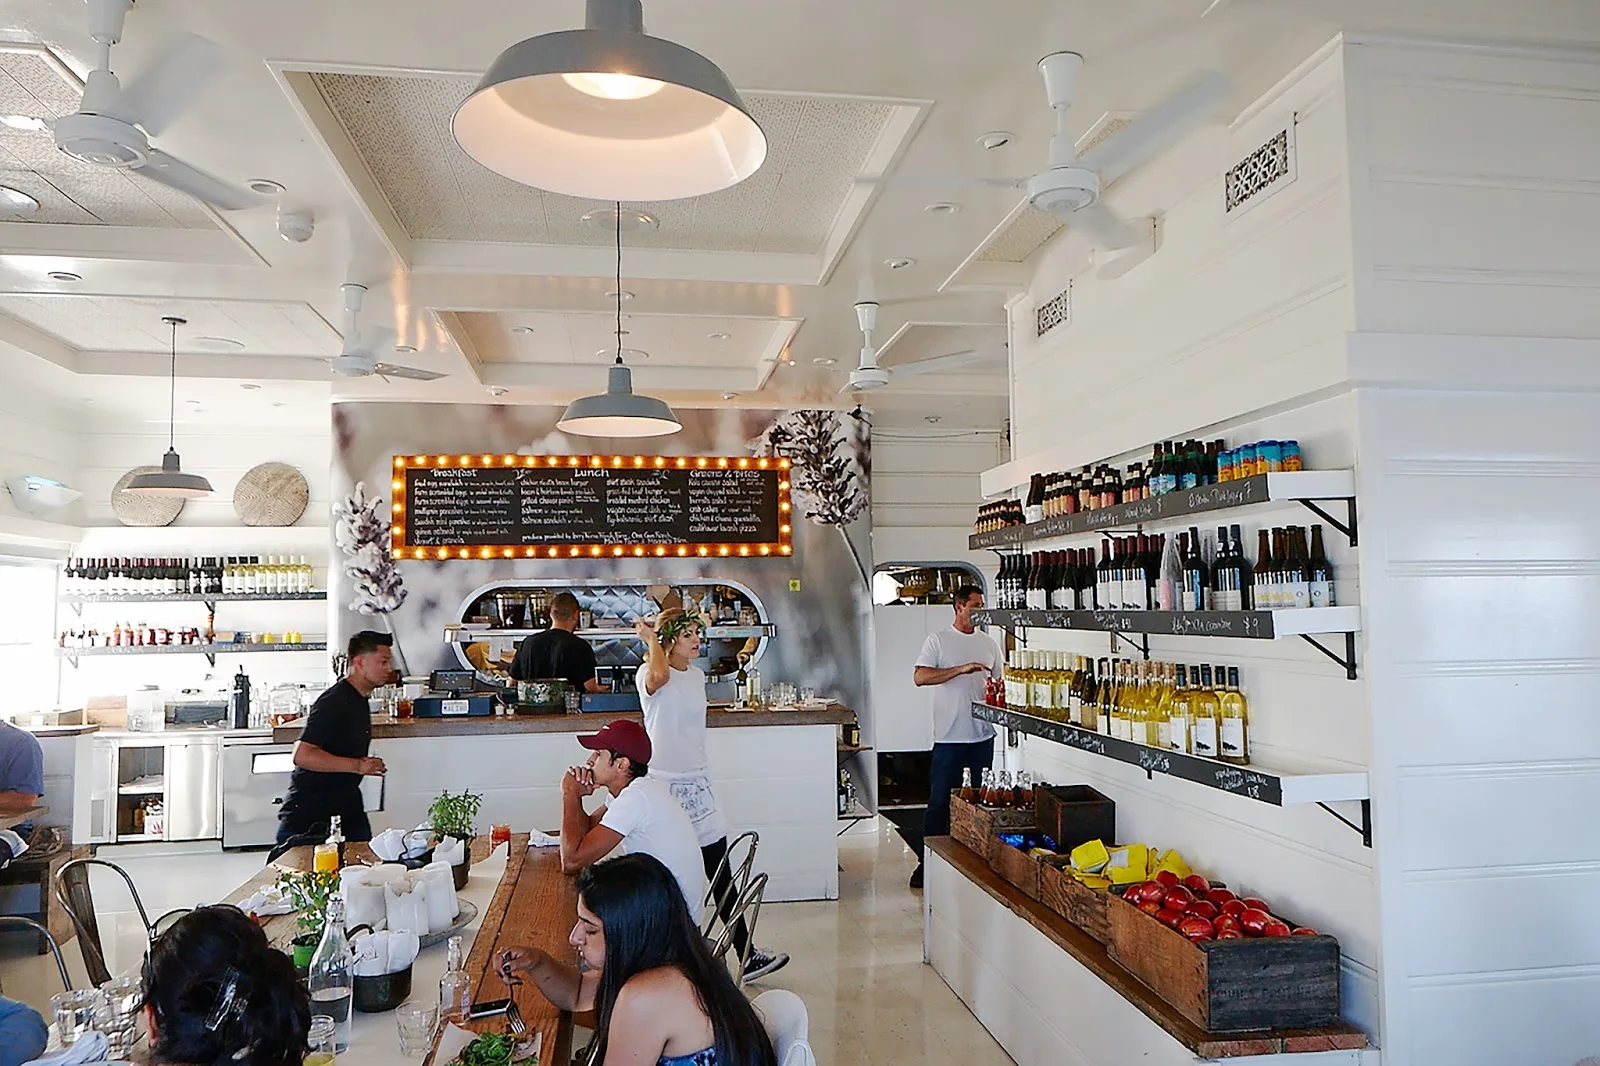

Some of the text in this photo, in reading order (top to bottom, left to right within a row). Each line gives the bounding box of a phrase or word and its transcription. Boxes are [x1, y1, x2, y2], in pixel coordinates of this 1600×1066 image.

[431, 468, 478, 477] Breakfast
[574, 468, 609, 477] Lunch
[739, 524, 756, 534] pizza
